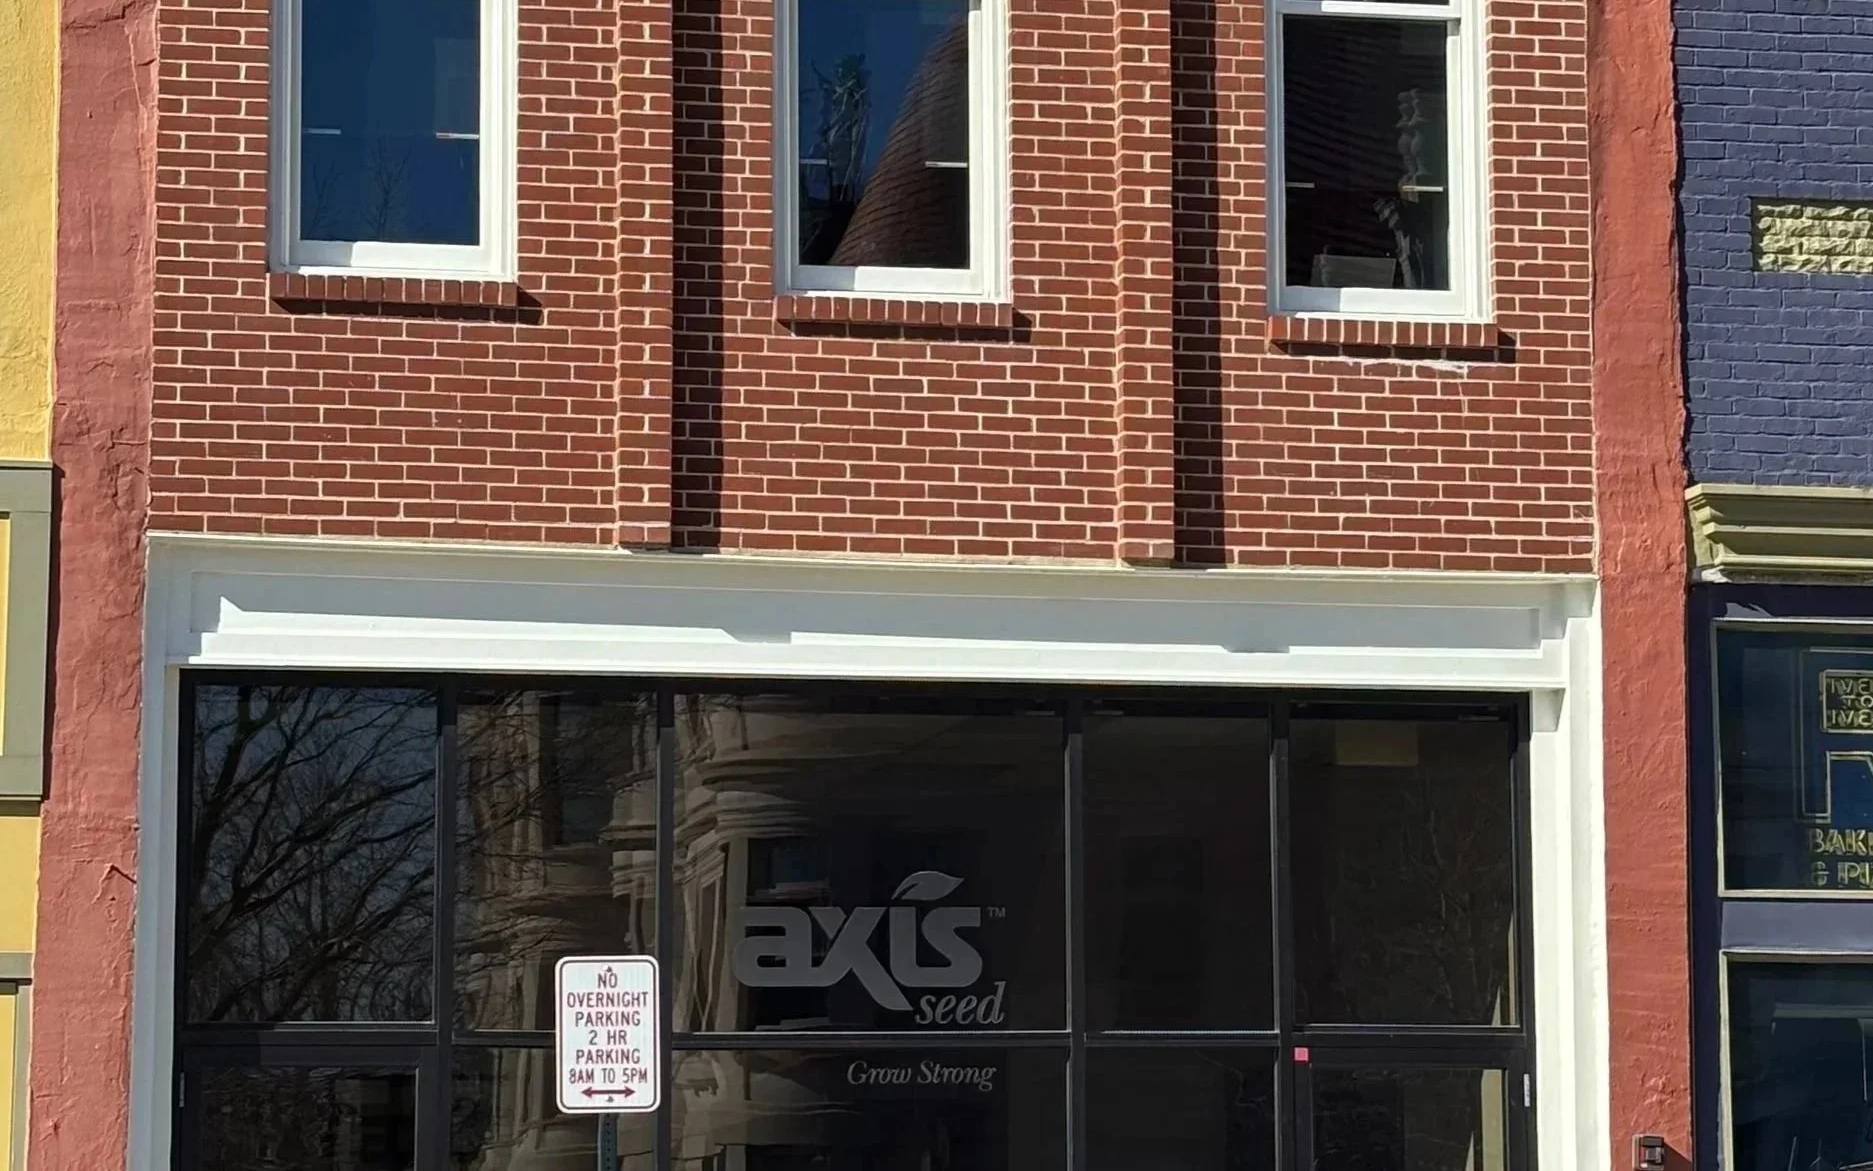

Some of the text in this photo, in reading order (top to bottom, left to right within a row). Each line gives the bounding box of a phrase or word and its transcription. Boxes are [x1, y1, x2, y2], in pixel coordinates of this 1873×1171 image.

[1810, 828, 1873, 855] BAK
[734, 871, 983, 1011] axis
[597, 972, 618, 988] NO
[566, 992, 648, 1008] OVERNIGHT
[914, 981, 1007, 1025] seed
[575, 1012, 641, 1027] PARKING
[588, 1030, 628, 1045] 2 HR
[576, 1049, 641, 1064] PARKING
[568, 1068, 648, 1084] 8AM TO 5PM
[847, 1060, 997, 1092] Grow Strong
